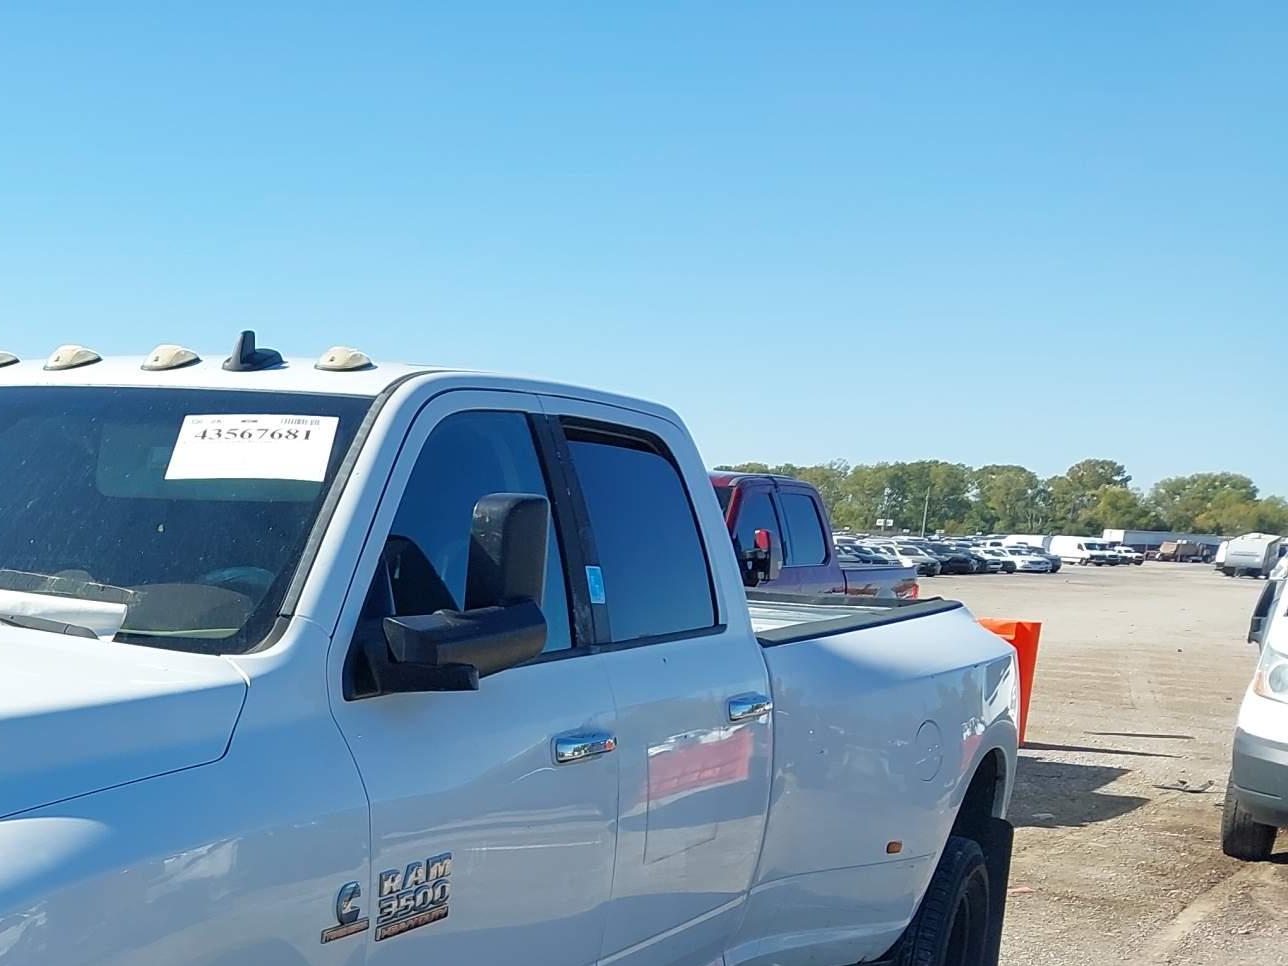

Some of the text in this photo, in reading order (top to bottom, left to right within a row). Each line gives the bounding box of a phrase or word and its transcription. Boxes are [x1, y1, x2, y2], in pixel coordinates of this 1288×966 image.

[194, 428, 313, 441] 43567681
[379, 851, 453, 897] RAM
[377, 878, 452, 925] 3500
